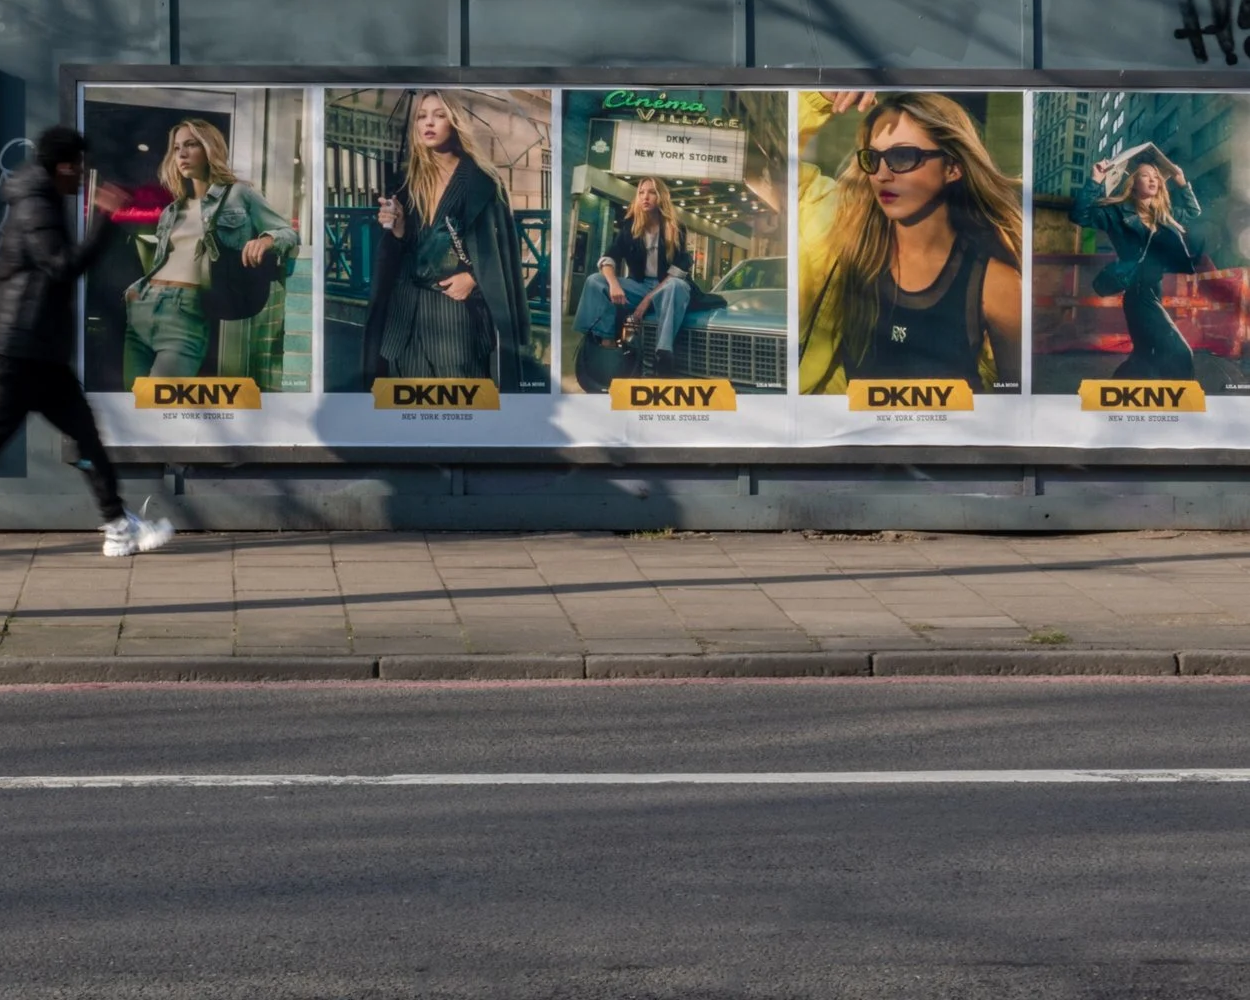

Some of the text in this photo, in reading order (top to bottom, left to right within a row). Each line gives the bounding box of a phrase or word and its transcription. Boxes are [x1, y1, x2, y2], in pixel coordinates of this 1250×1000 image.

[636, 108, 743, 129] VILLAGE
[666, 135, 692, 144] DKNY
[634, 148, 728, 164] NEW YORK STORIES
[154, 384, 242, 405] DKNY
[393, 385, 480, 406] DKNY
[630, 385, 717, 407] DKNY
[867, 386, 954, 407] DKNY
[1100, 387, 1186, 408] DKNY
[401, 413, 473, 421] NEW YORK STORIES
[876, 414, 948, 422] NEW YORK STORIES
